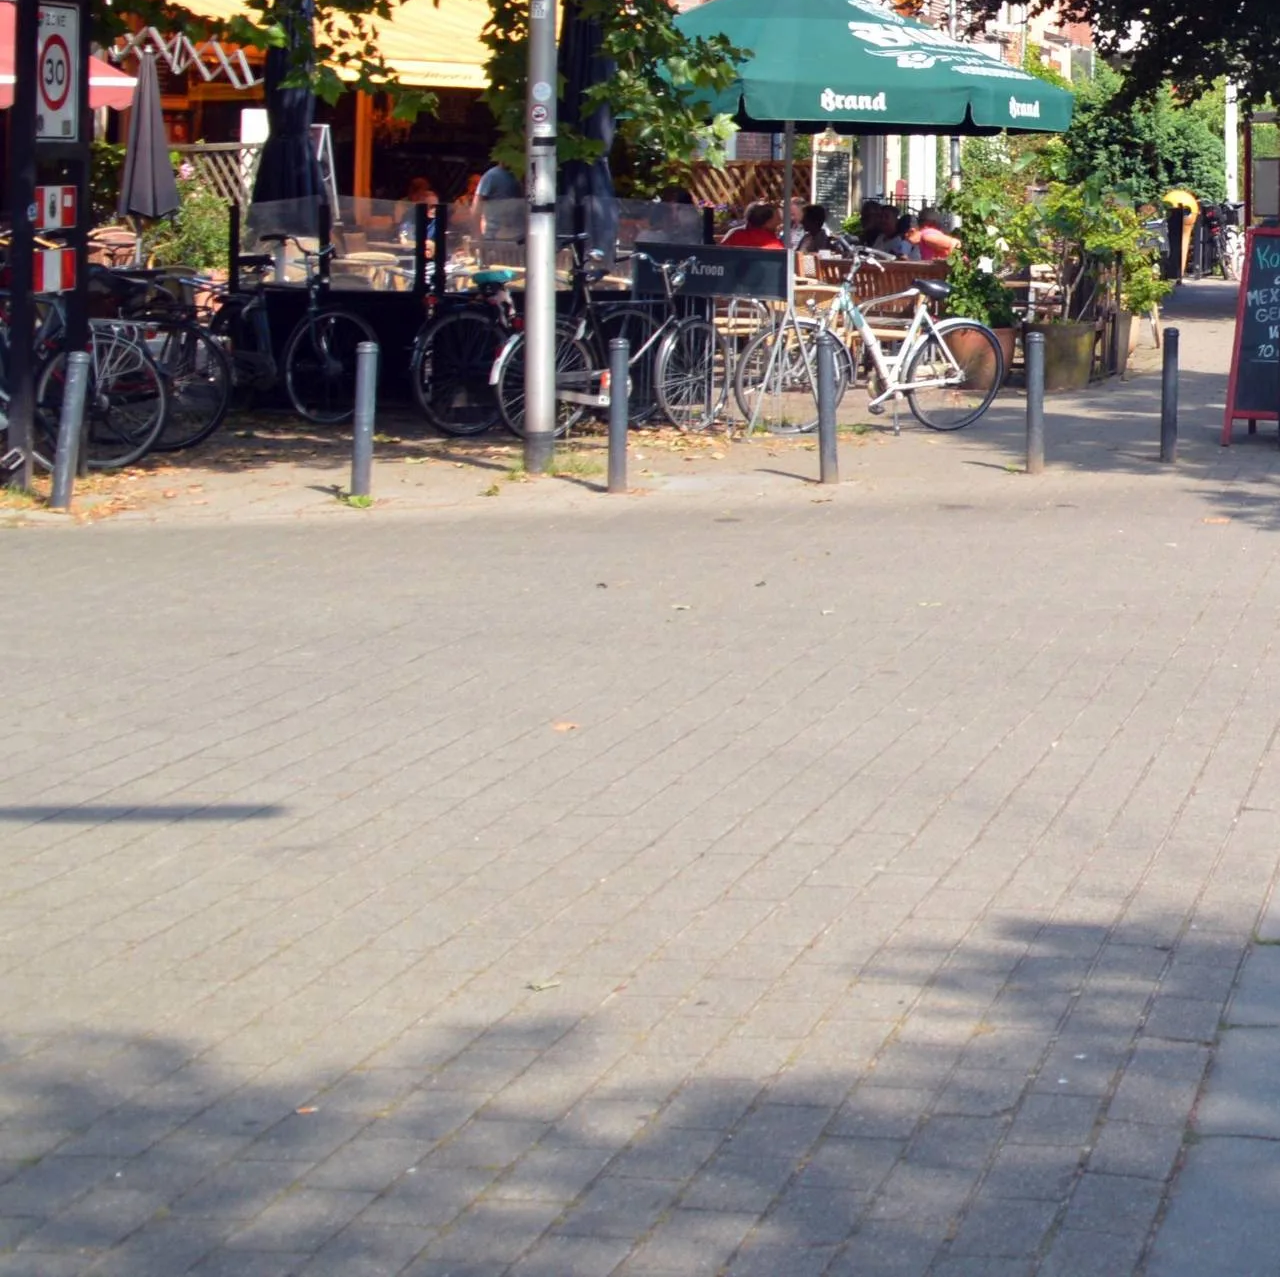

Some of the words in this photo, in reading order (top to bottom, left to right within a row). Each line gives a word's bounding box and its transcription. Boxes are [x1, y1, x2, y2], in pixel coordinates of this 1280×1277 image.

[45, 59, 65, 85] 30
[820, 87, 888, 112] Brand
[1008, 95, 1041, 119] Brand
[691, 261, 725, 277] Kroon
[1257, 344, 1274, 358] 10
